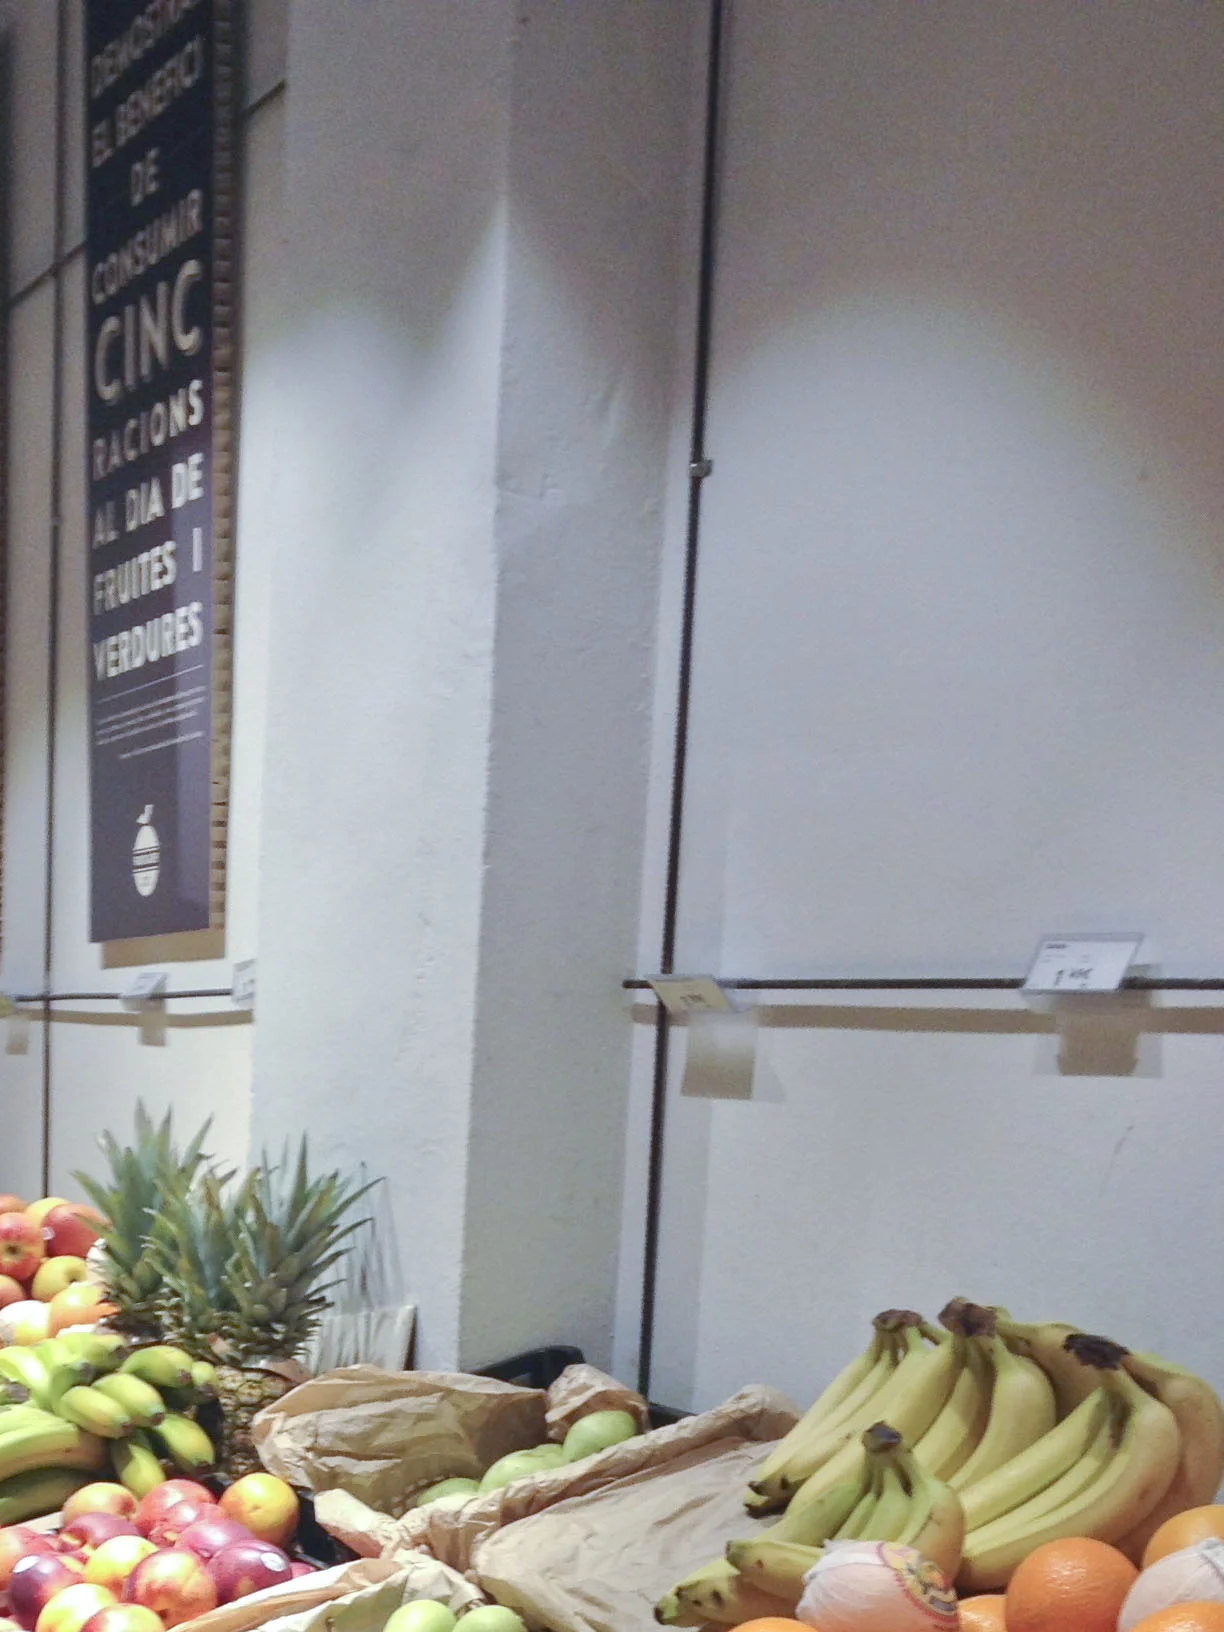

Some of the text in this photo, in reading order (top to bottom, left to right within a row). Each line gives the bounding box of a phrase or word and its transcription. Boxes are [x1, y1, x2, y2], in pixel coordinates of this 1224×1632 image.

[131, 147, 159, 207] DE
[92, 188, 203, 304] CONSUMIR
[94, 259, 204, 406] CINC
[93, 379, 204, 481] RACIONS
[93, 452, 204, 549] AL DIA DE
[93, 527, 203, 616] FRUITES I
[93, 601, 204, 681] VERDURES
